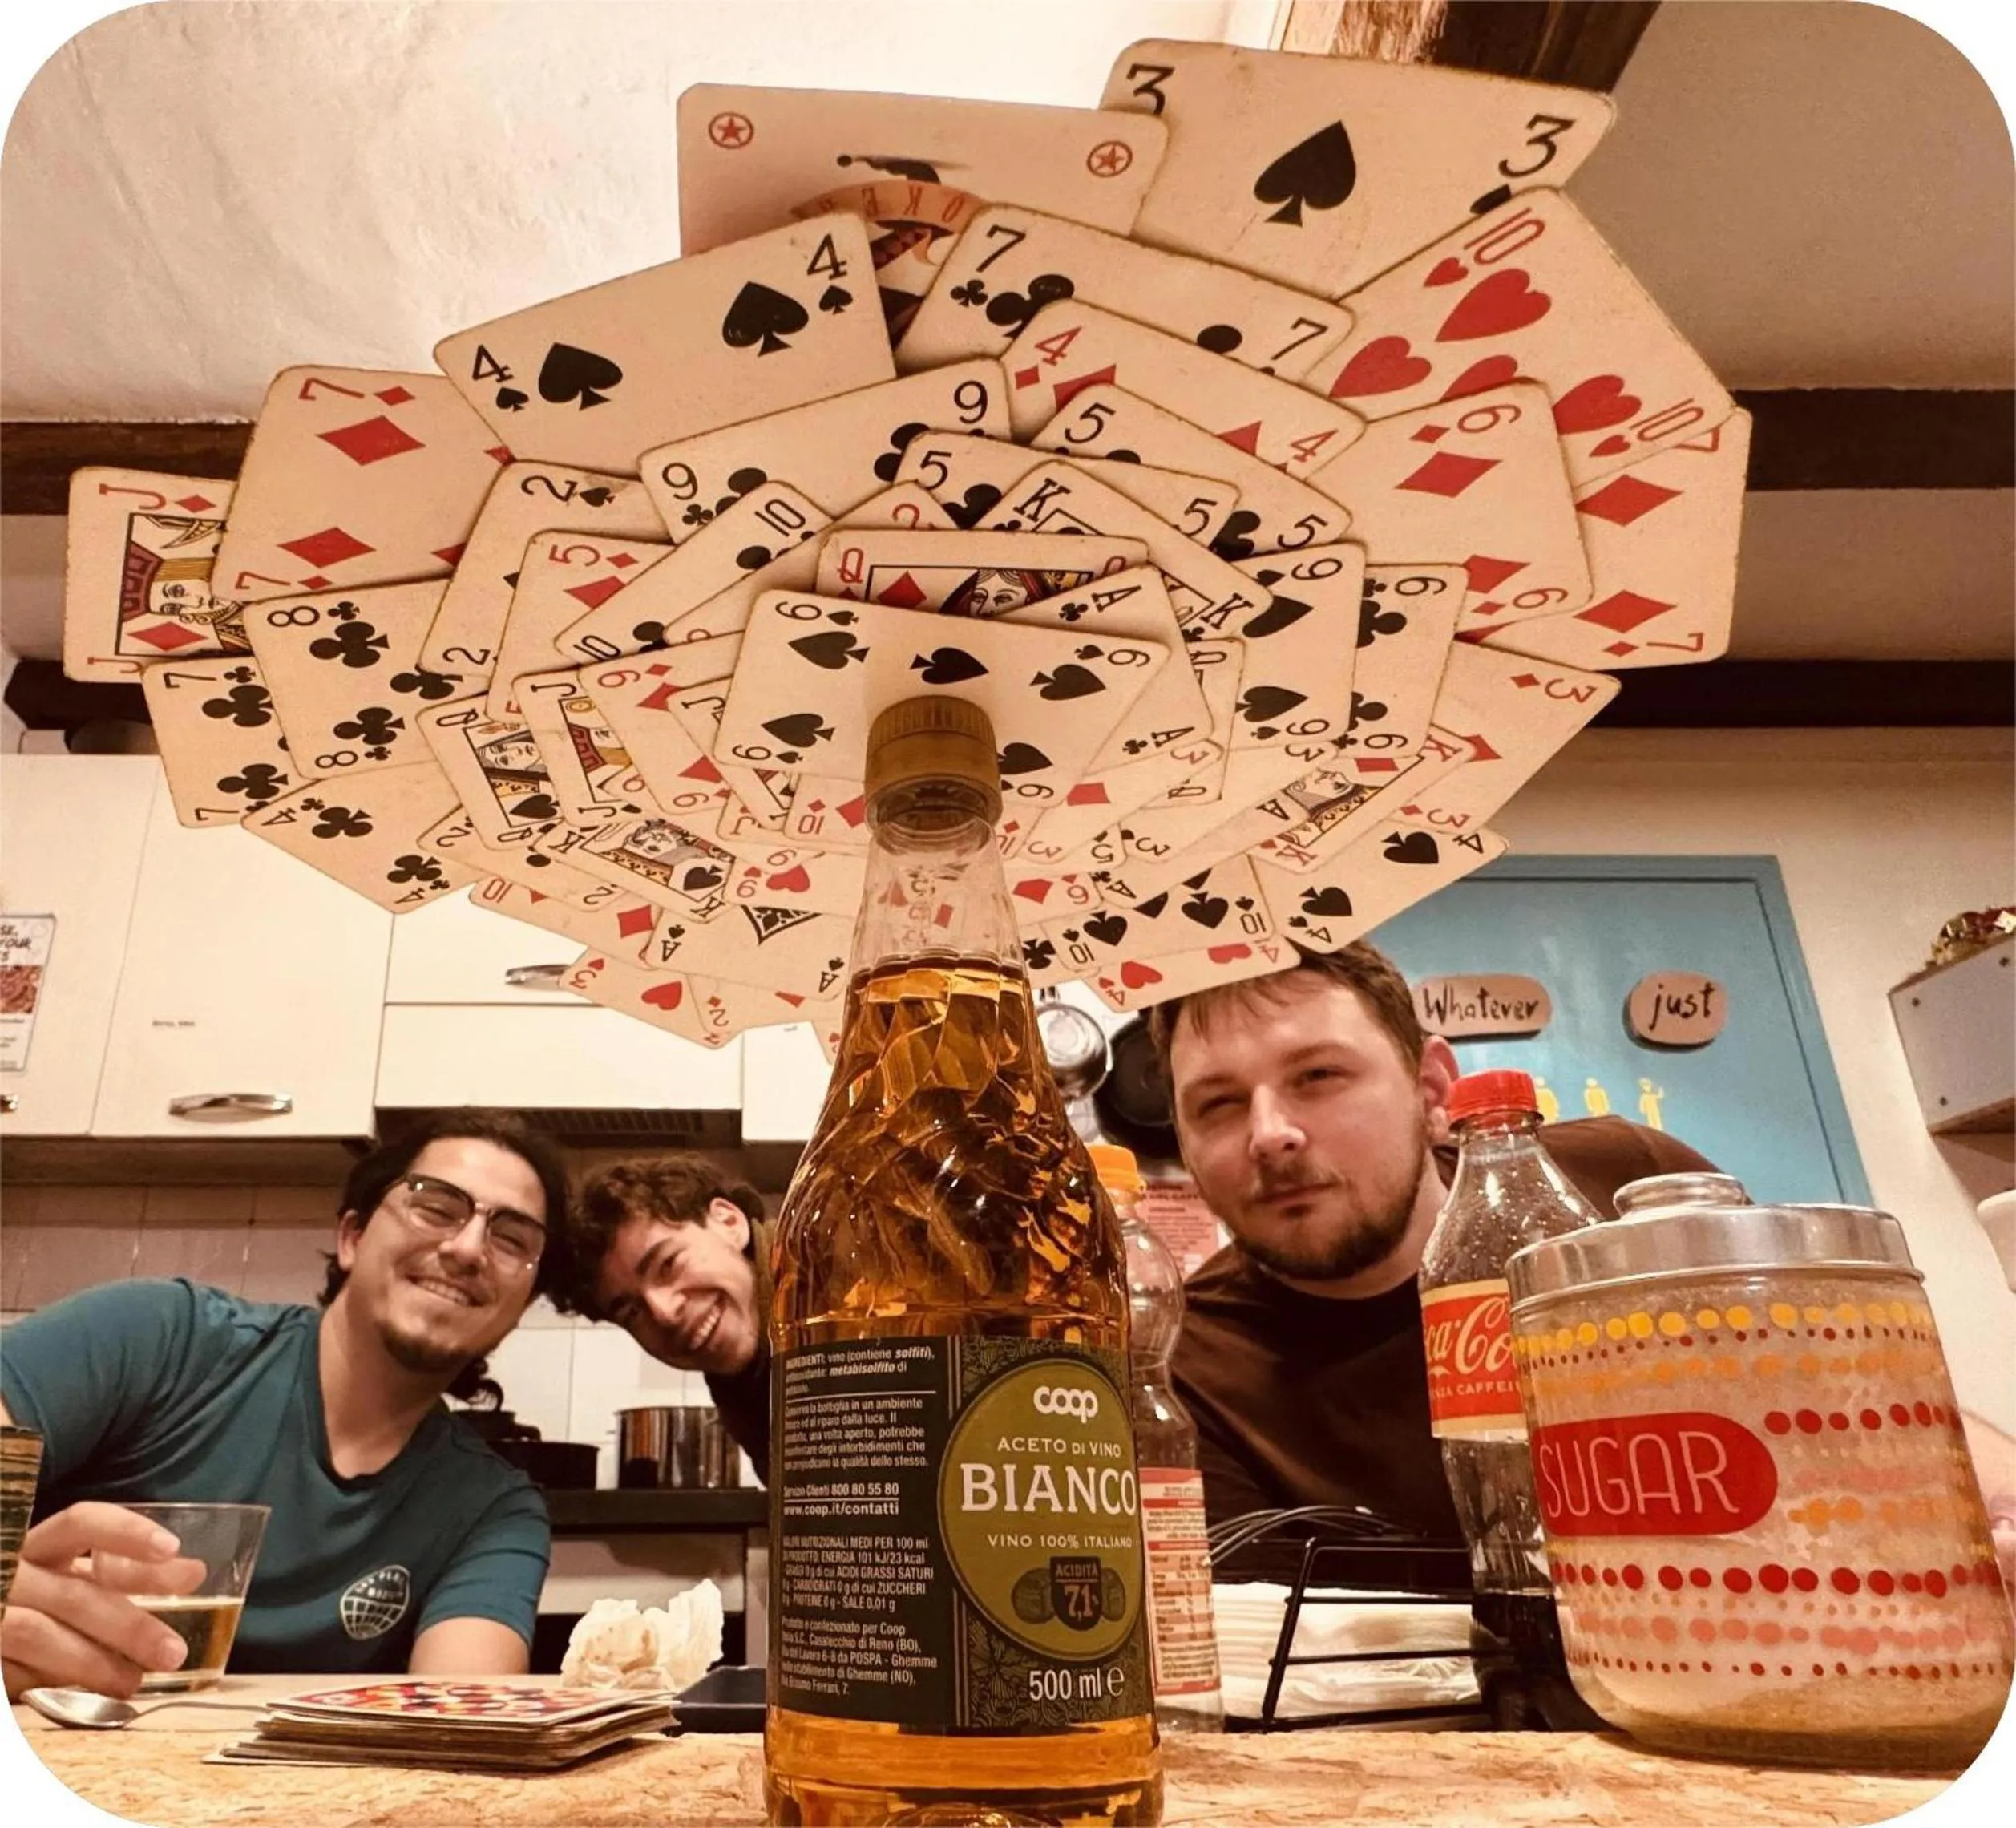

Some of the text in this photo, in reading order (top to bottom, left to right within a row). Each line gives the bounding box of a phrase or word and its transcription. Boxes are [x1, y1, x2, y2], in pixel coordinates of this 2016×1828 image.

[1126, 63, 1175, 115] 3
[1498, 114, 1576, 178] 3
[1464, 208, 1545, 265] 10
[806, 233, 847, 279] 4
[976, 224, 1026, 273] 7
[1034, 326, 1081, 366] 4
[1271, 317, 1327, 361] 7
[471, 345, 514, 382] 4
[299, 378, 364, 400] 7
[954, 380, 988, 424] 9
[1065, 402, 1115, 444] 5
[1457, 404, 1521, 433] 6
[1629, 398, 1704, 442] 10
[1290, 429, 1339, 463] 4
[921, 450, 952, 490] 5
[521, 475, 578, 503] 2
[662, 463, 698, 500] 9
[99, 483, 166, 510] J
[1013, 478, 1071, 522] K
[755, 499, 806, 537] 10
[1177, 497, 1218, 537] 5
[1278, 514, 1328, 549] 5
[548, 544, 600, 567] 5
[838, 548, 864, 584] Q
[1291, 557, 1343, 580] 9
[236, 572, 291, 590] 7
[1395, 576, 1447, 597] 6
[1091, 584, 1142, 613] A
[1513, 588, 1568, 609] 6
[267, 605, 320, 628] 8
[775, 601, 822, 621] 6
[1200, 592, 1254, 630] K
[573, 635, 622, 661] 10
[1646, 632, 1703, 653] 7
[442, 647, 490, 665] 2
[1108, 649, 1150, 668] 6
[164, 672, 216, 690] 7
[597, 669, 640, 688] 9
[531, 682, 576, 697] J
[1545, 679, 1597, 704] 3
[436, 708, 478, 726] Q
[1286, 719, 1330, 735] 9
[1151, 726, 1194, 747] A
[1364, 733, 1408, 749] 6
[732, 745, 771, 761] 6
[1170, 748, 1210, 765] 3
[1285, 744, 1324, 762] 3
[1424, 734, 1463, 762] K
[315, 750, 358, 768] 8
[1017, 783, 1054, 799] 6
[1167, 786, 1206, 799] Q
[195, 807, 240, 821] 7
[261, 807, 297, 826] 4
[577, 805, 617, 818] J
[1255, 799, 1290, 821] A
[1427, 808, 1470, 827] 3
[497, 827, 533, 842] Q
[798, 814, 824, 835] 10
[436, 827, 471, 847] 2
[548, 831, 586, 854] K
[1136, 837, 1170, 855] 3
[1452, 833, 1484, 853] 4
[1028, 841, 1062, 858] 3
[1091, 843, 1114, 863] 5
[1275, 845, 1318, 866] K
[394, 888, 426, 904] 4
[483, 878, 512, 903] 10
[584, 886, 614, 904] 2
[1105, 880, 1137, 899] A
[690, 896, 725, 919] K
[1240, 912, 1266, 934] 10
[1305, 927, 1332, 944] 4
[661, 940, 681, 961] A
[1069, 942, 1095, 965] 10
[569, 969, 597, 989] 3
[819, 971, 839, 993] A
[1106, 989, 1125, 1006] 4
[1423, 984, 1540, 1025] Whatever
[1648, 981, 1716, 1032] just
[709, 1009, 729, 1027] 2
[830, 1362, 895, 1377] metabisolfito
[897, 1361, 907, 1373] di
[875, 1397, 923, 1409] ambiente
[1033, 1386, 1098, 1423] coop
[879, 1426, 925, 1440] potrebbe
[907, 1440, 926, 1451] che
[998, 1437, 1121, 1458] ACETO DI VINO
[1539, 1431, 1739, 1518] SUGAR
[831, 1483, 849, 1496] 800
[851, 1483, 865, 1496] 80
[867, 1482, 881, 1495] 55
[884, 1482, 899, 1495] 80
[961, 1464, 1137, 1515] BIANCO
[783, 1502, 899, 1517] www.coop.it/contatti
[850, 1536, 928, 1549] MEDI PER 100 ml
[988, 1535, 1132, 1548] VINO 100% ITALIANO
[904, 1551, 925, 1564] kcal
[860, 1567, 895, 1579] GRASSI
[898, 1567, 934, 1579] SATURI
[877, 1582, 926, 1595] ZUCCHERI
[842, 1596, 864, 1609] SALE
[880, 1621, 906, 1636] Coop
[850, 1652, 937, 1668] POSPA Ghemme
[1029, 1670, 1072, 1701] 500
[1079, 1668, 1101, 1698] ml
